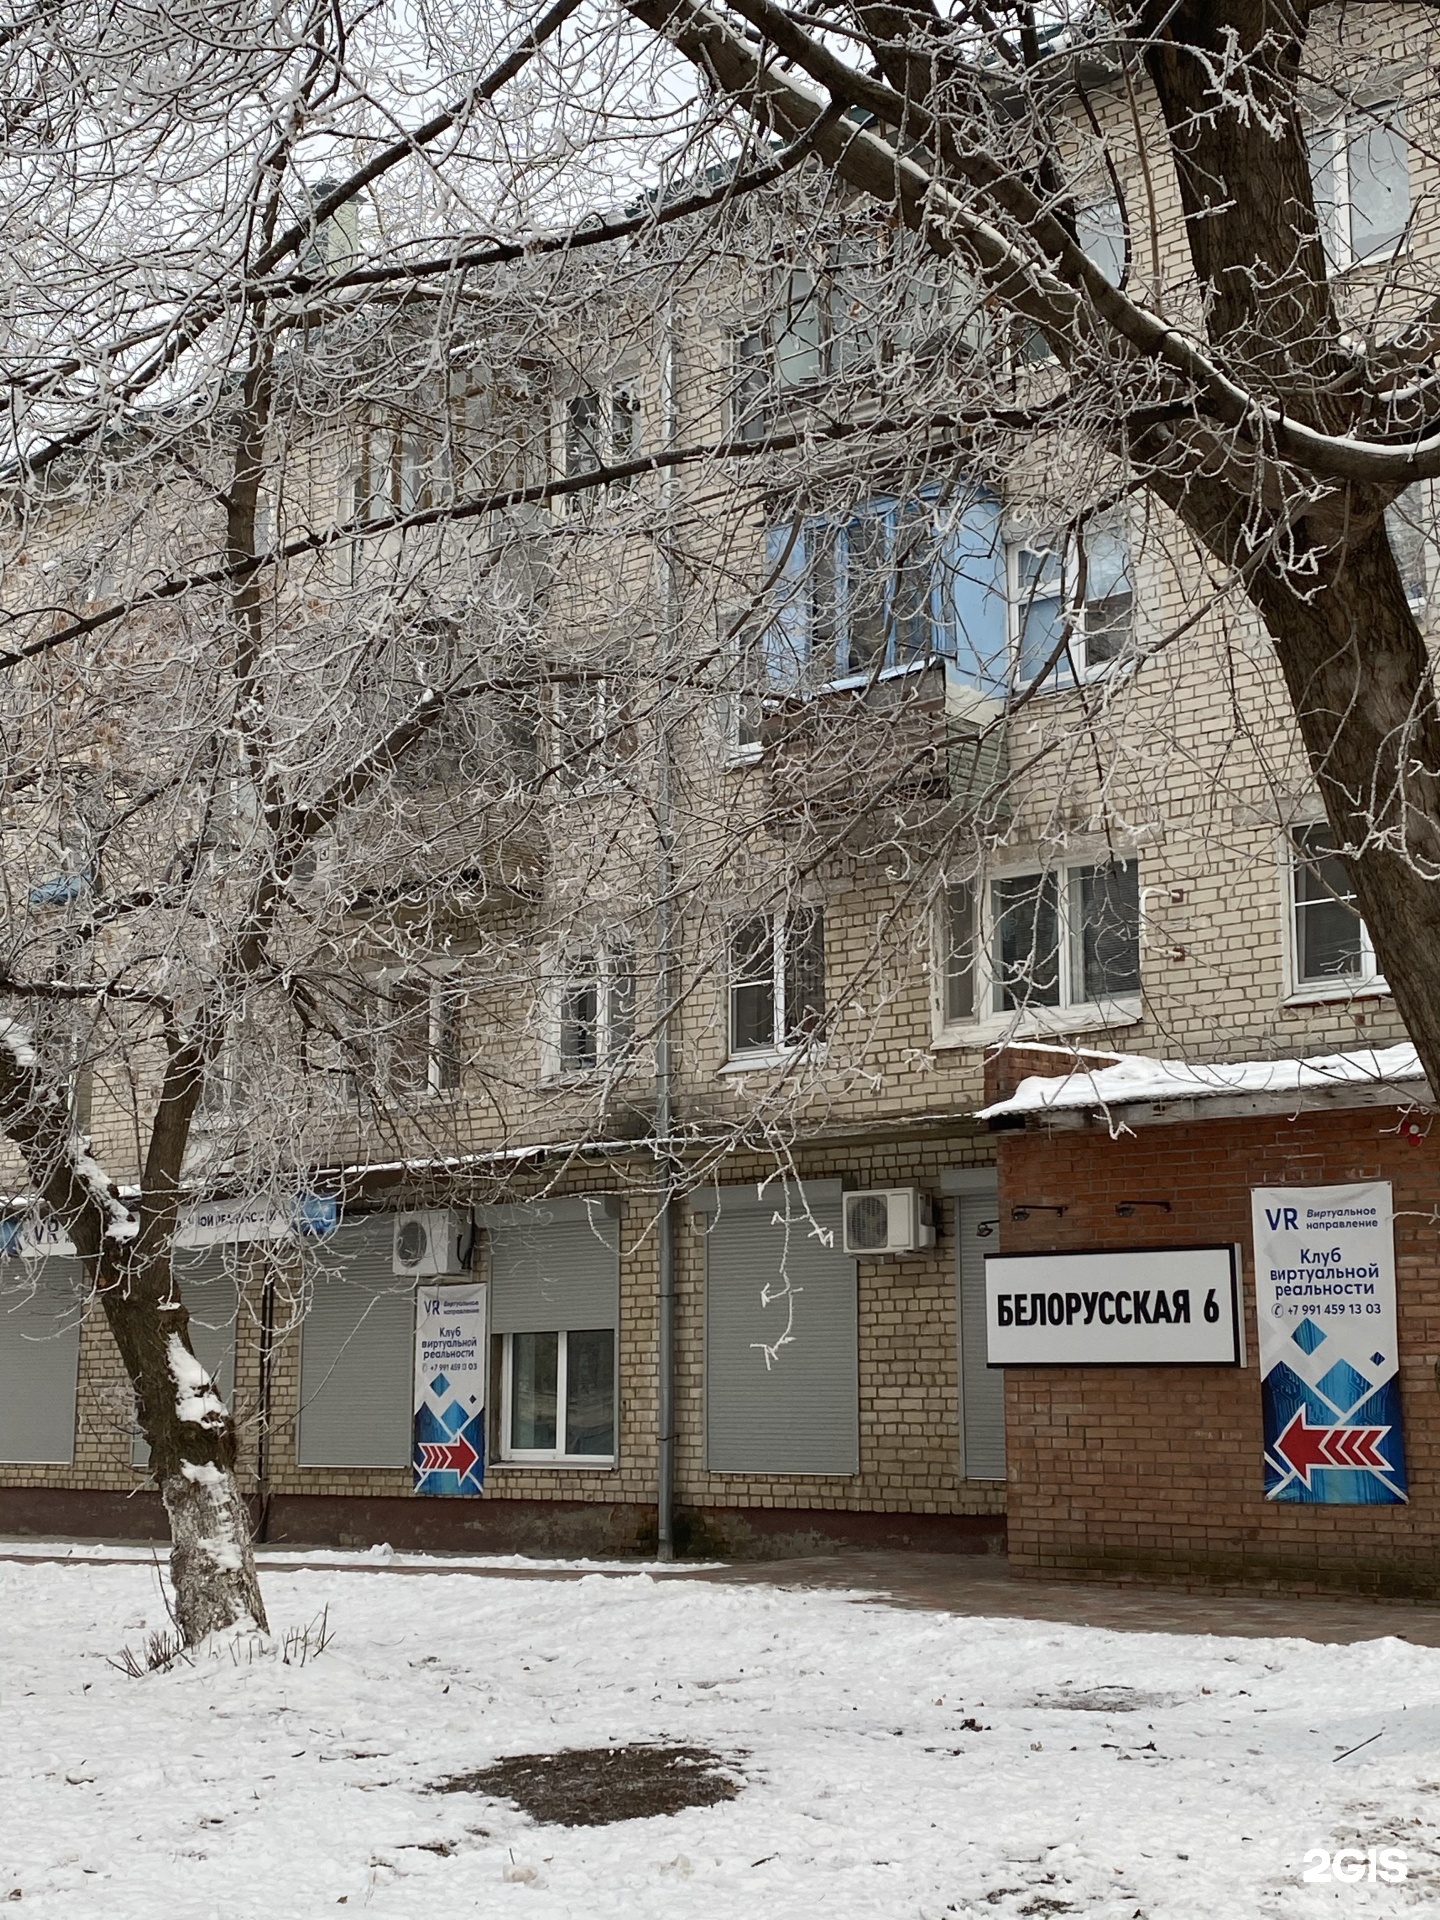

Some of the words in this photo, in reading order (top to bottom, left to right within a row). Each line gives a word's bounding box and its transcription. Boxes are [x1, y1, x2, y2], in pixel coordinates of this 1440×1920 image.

[1265, 1207, 1299, 1231] VR
[1306, 1207, 1377, 1219] Виртуальное
[1306, 1219, 1379, 1231] направление
[1300, 1247, 1342, 1267] Клуб
[1270, 1263, 1379, 1283] виртуальной
[1275, 1283, 1375, 1300] реальности
[424, 1300, 440, 1315] VR
[997, 1289, 1191, 1327] БЕЛОРУССКАЯ
[1203, 1288, 1220, 1323] 6
[1288, 1305, 1299, 1316] +7
[1302, 1304, 1321, 1316] 991
[1324, 1304, 1346, 1315] 459
[1348, 1303, 1362, 1315] 13
[1365, 1303, 1382, 1315] 03
[439, 1326, 462, 1339] Клуб
[422, 1337, 477, 1349] виртуальной
[423, 1349, 474, 1361] реальности
[468, 1362, 478, 1370] 03
